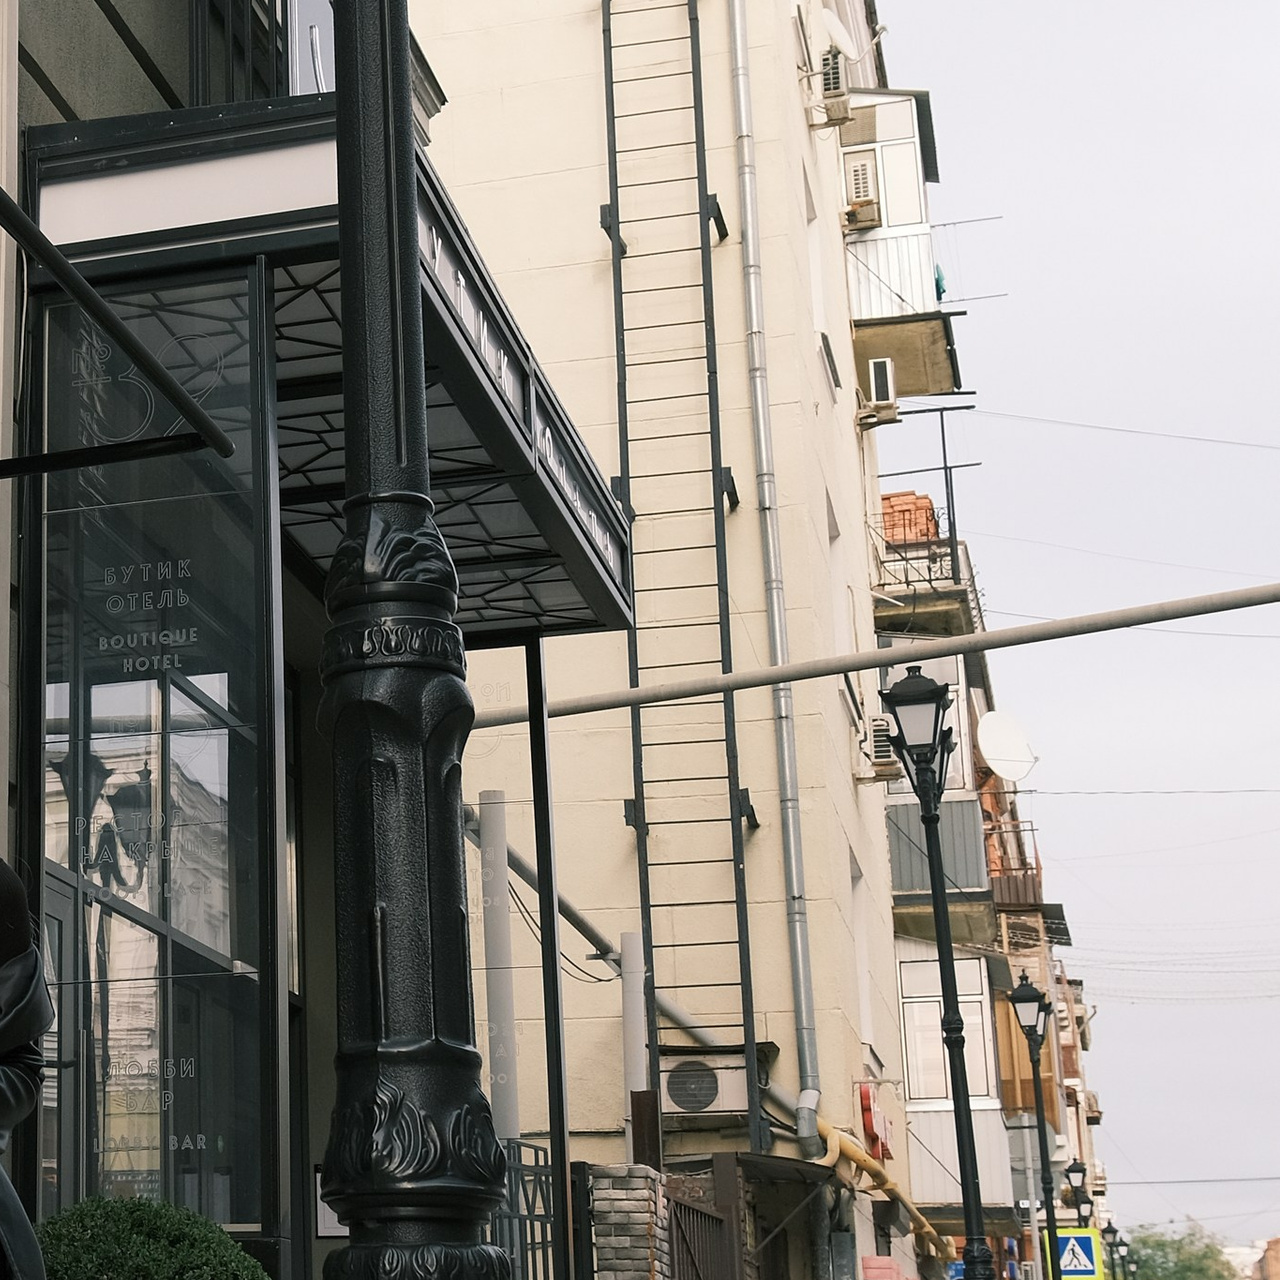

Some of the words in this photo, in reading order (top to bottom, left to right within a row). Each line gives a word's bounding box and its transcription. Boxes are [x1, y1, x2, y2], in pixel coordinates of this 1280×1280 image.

[428, 225, 510, 400] УТИК
[104, 559, 192, 586] БУТИК
[106, 588, 190, 614] ОТЕЛЬ
[99, 627, 198, 651] BOUTIQUE
[123, 653, 182, 673] HOTEL
[81, 844, 114, 865] НА
[128, 836, 219, 861] КРЫШЕ
[105, 1057, 195, 1081] ЛОББИ
[125, 1090, 174, 1112] БАР
[168, 1134, 206, 1151] BAR
